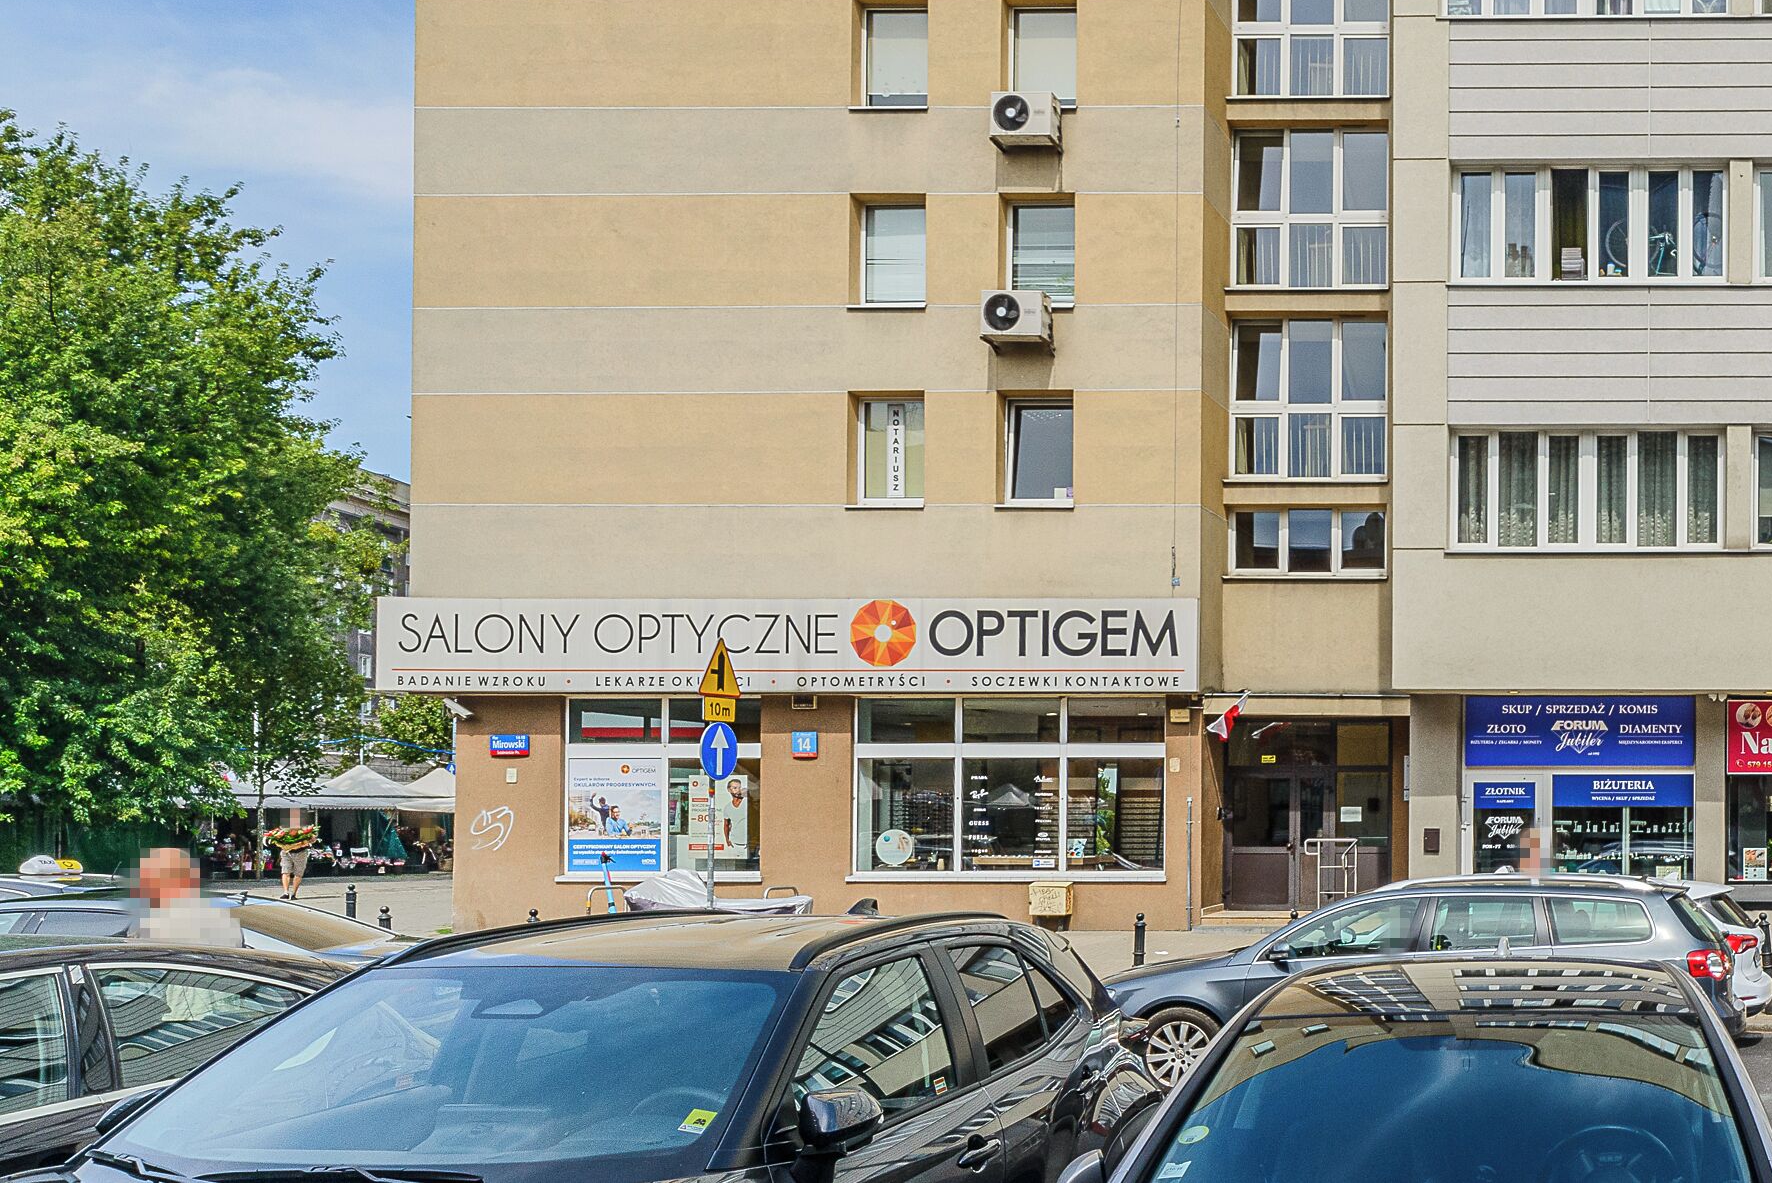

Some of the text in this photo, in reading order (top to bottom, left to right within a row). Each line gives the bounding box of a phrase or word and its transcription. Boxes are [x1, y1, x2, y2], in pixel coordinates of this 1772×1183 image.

[892, 409, 900, 491] NOTARIUSZ
[398, 610, 1179, 656] SALONY OPTYCZNE OPTIGEM
[397, 676, 472, 686] BADANIE
[478, 676, 546, 686] WZROKU
[595, 676, 665, 687] LEKARZE
[797, 673, 926, 687] OPTOMETRYŚCI
[971, 676, 1058, 687] SOCZEWKI
[1065, 676, 1179, 687] KONTAKTOWE
[709, 702, 731, 717] 10m
[1502, 702, 1658, 714] SKUP SPRZEDAŻ KOMIS
[1486, 724, 1682, 734] ZŁOTO DIAMENTY
[1552, 720, 1608, 730] FORUM
[492, 739, 525, 749] Mirowski
[797, 737, 811, 752] 14
[1555, 732, 1604, 752] Jubiler
[1747, 760, 1761, 768] 579
[1592, 778, 1655, 790] BIŻUTERIA
[1484, 787, 1526, 796] ZŁOTNIK
[1486, 816, 1524, 824] FORUM
